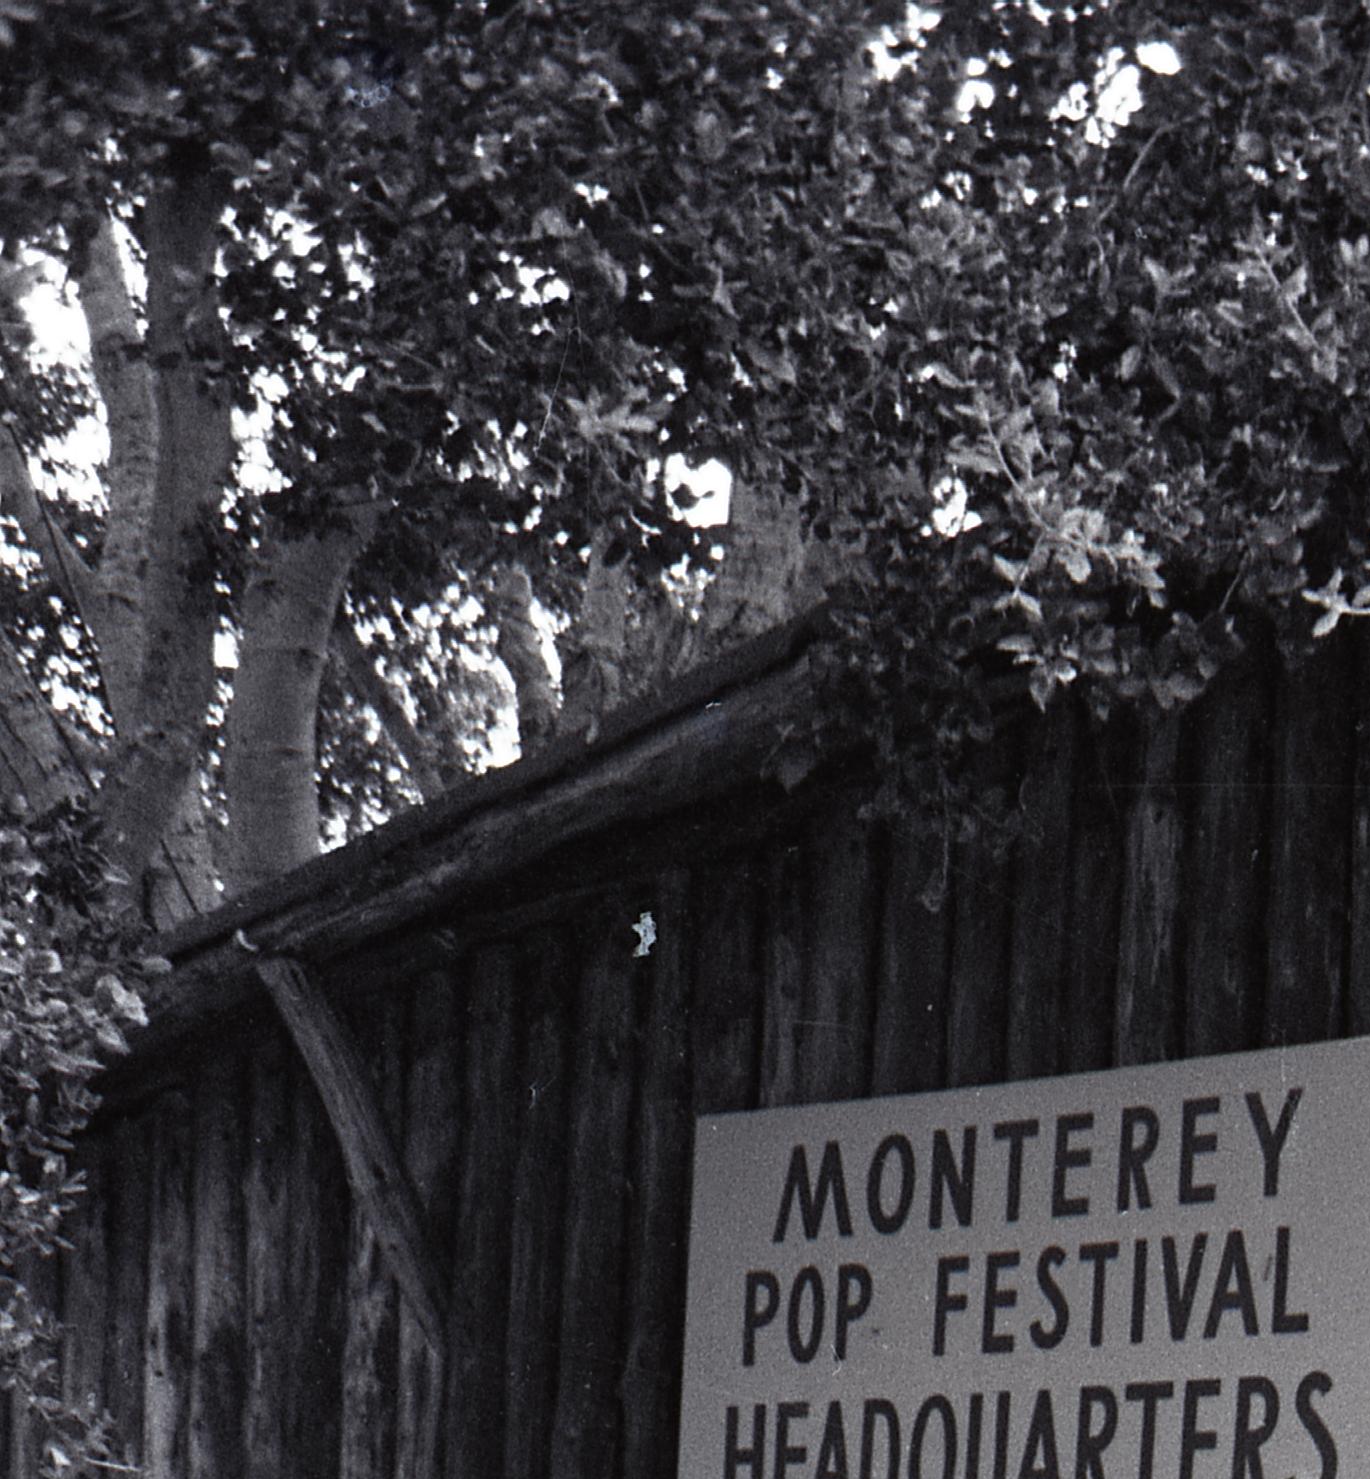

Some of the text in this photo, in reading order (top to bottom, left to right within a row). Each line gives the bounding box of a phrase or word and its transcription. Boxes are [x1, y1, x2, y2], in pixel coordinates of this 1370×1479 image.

[773, 1088, 1302, 1243] MONTEREY
[743, 1226, 1309, 1366] POP FESTIVAL
